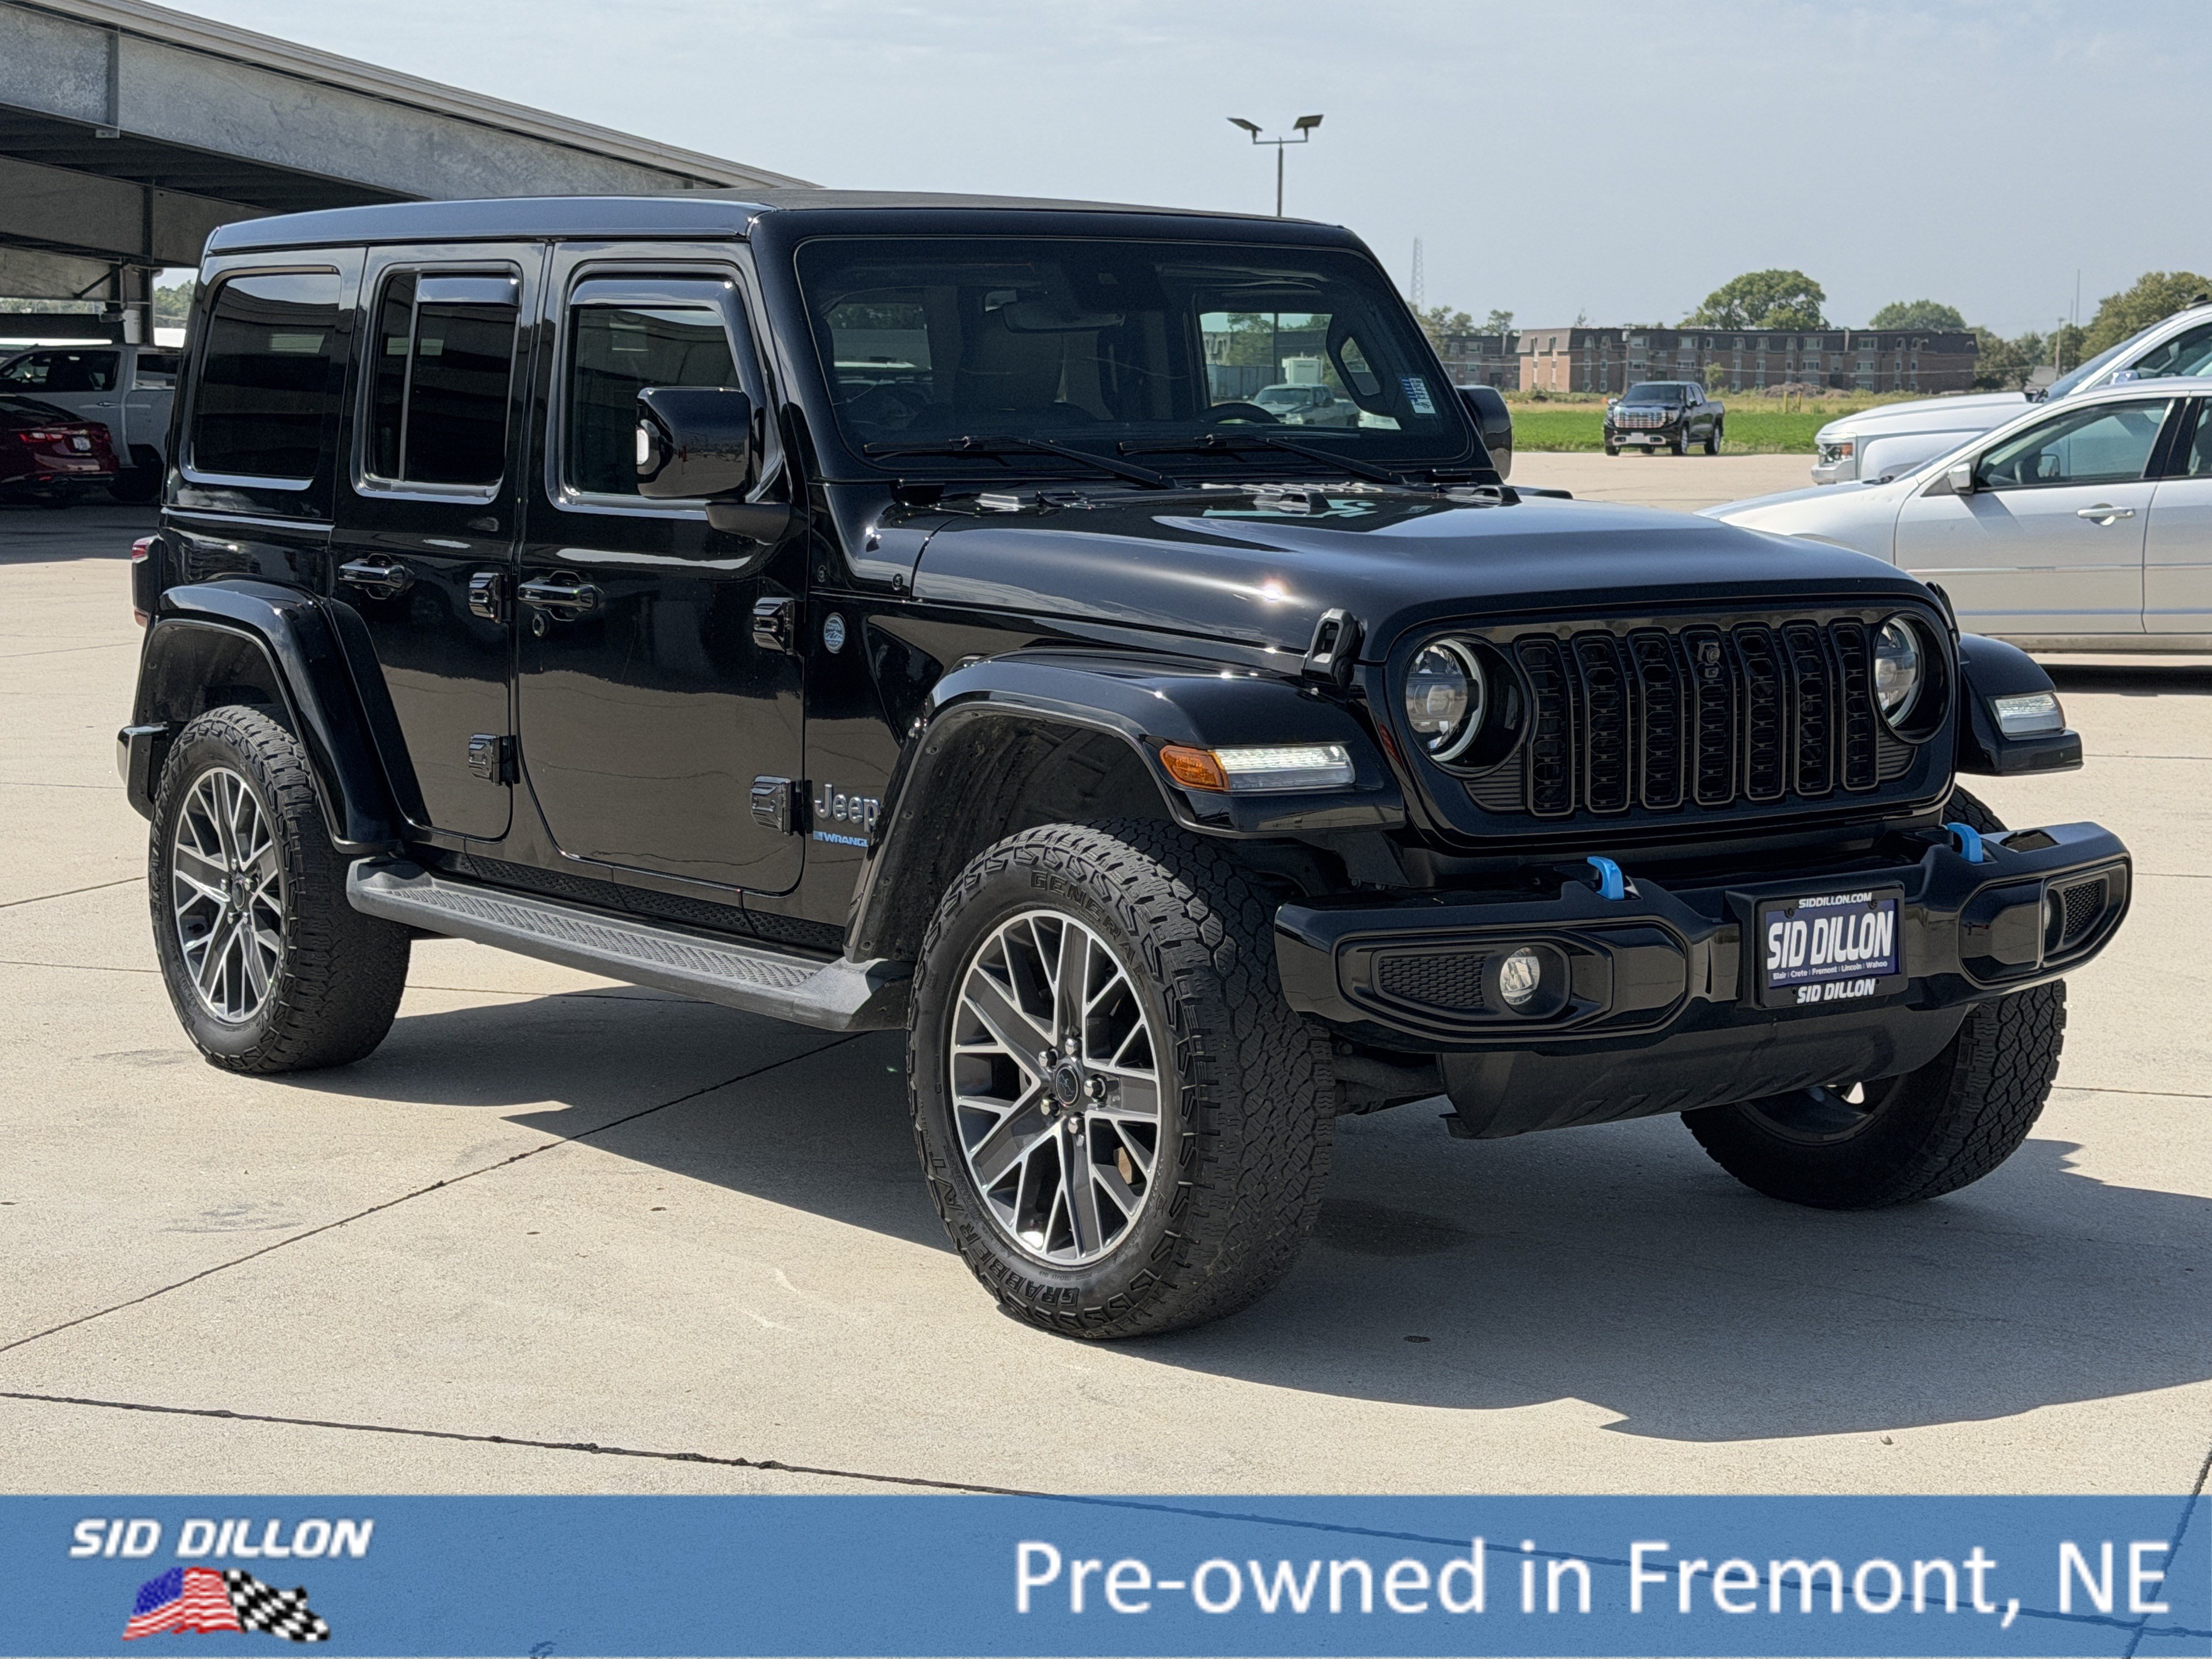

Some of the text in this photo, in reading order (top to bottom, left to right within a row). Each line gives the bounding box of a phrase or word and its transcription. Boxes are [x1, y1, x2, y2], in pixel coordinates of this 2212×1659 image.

[814, 783, 881, 833] Jeep
[823, 832, 868, 848] WRANGL
[1798, 892, 1872, 909] SIDDILLON.COM
[1030, 869, 1146, 991] GENERAL
[1767, 910, 1894, 970] SID DILLON
[1790, 969, 1808, 978] Crete
[1812, 966, 1838, 975] Fremont
[1866, 960, 1888, 969] Wahoo
[1797, 978, 1876, 1004] SID DILLON
[960, 1222, 1080, 1307] GRABBER
